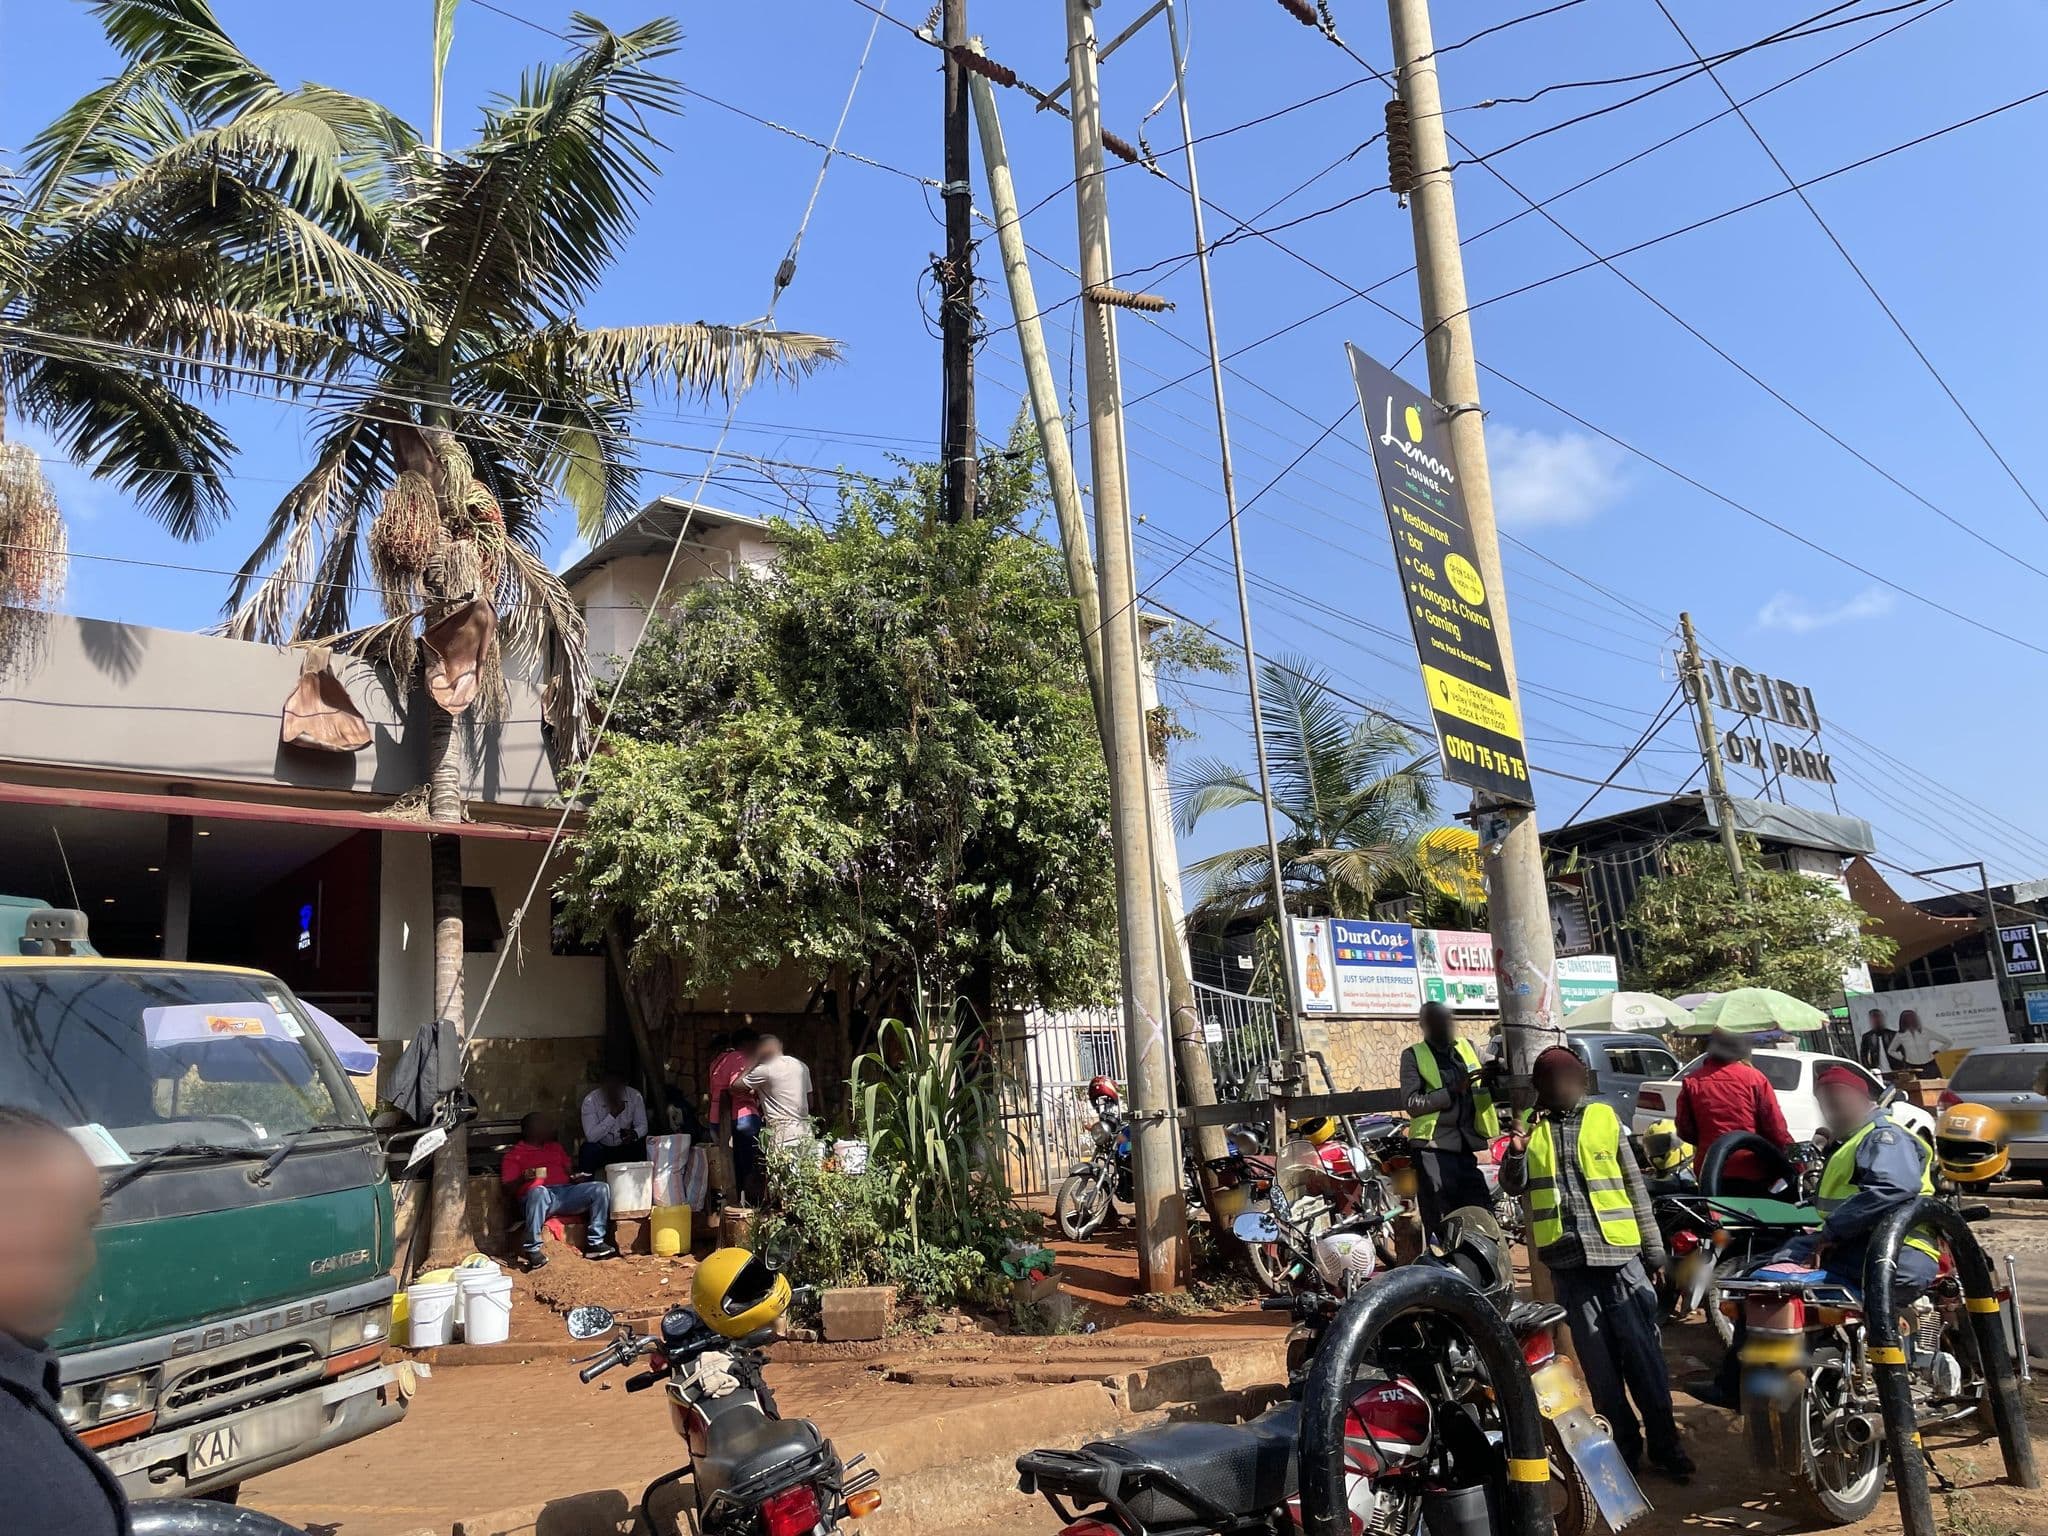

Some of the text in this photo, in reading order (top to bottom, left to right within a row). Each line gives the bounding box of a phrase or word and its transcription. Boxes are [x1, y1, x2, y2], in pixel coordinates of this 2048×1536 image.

[1380, 396, 1454, 484] Lemon
[1405, 463, 1440, 493] LOUNGE
[1401, 506, 1450, 546] Restaurant
[1407, 532, 1424, 553] Bar
[1413, 556, 1436, 581] Cafe
[1418, 582, 1452, 613] Koroga
[1452, 598, 1460, 615] &
[1459, 602, 1490, 630] Choma
[1425, 608, 1463, 642] Gaming
[1446, 734, 1527, 782] 0707 75 75 75
[1770, 742, 1838, 785] PARK
[1335, 926, 1404, 947] DuraCoat
[2001, 928, 2031, 942] GATE
[2012, 942, 2029, 960] A
[1567, 960, 1613, 974] CONNECT COFFEE
[2007, 960, 2038, 973] ENTRY
[1344, 975, 1414, 985] JUST SHOP ENTERPRISES
[310, 1249, 371, 1275] CANTER
[171, 1299, 328, 1357] CANTER
[1378, 1388, 1405, 1403] TVS
